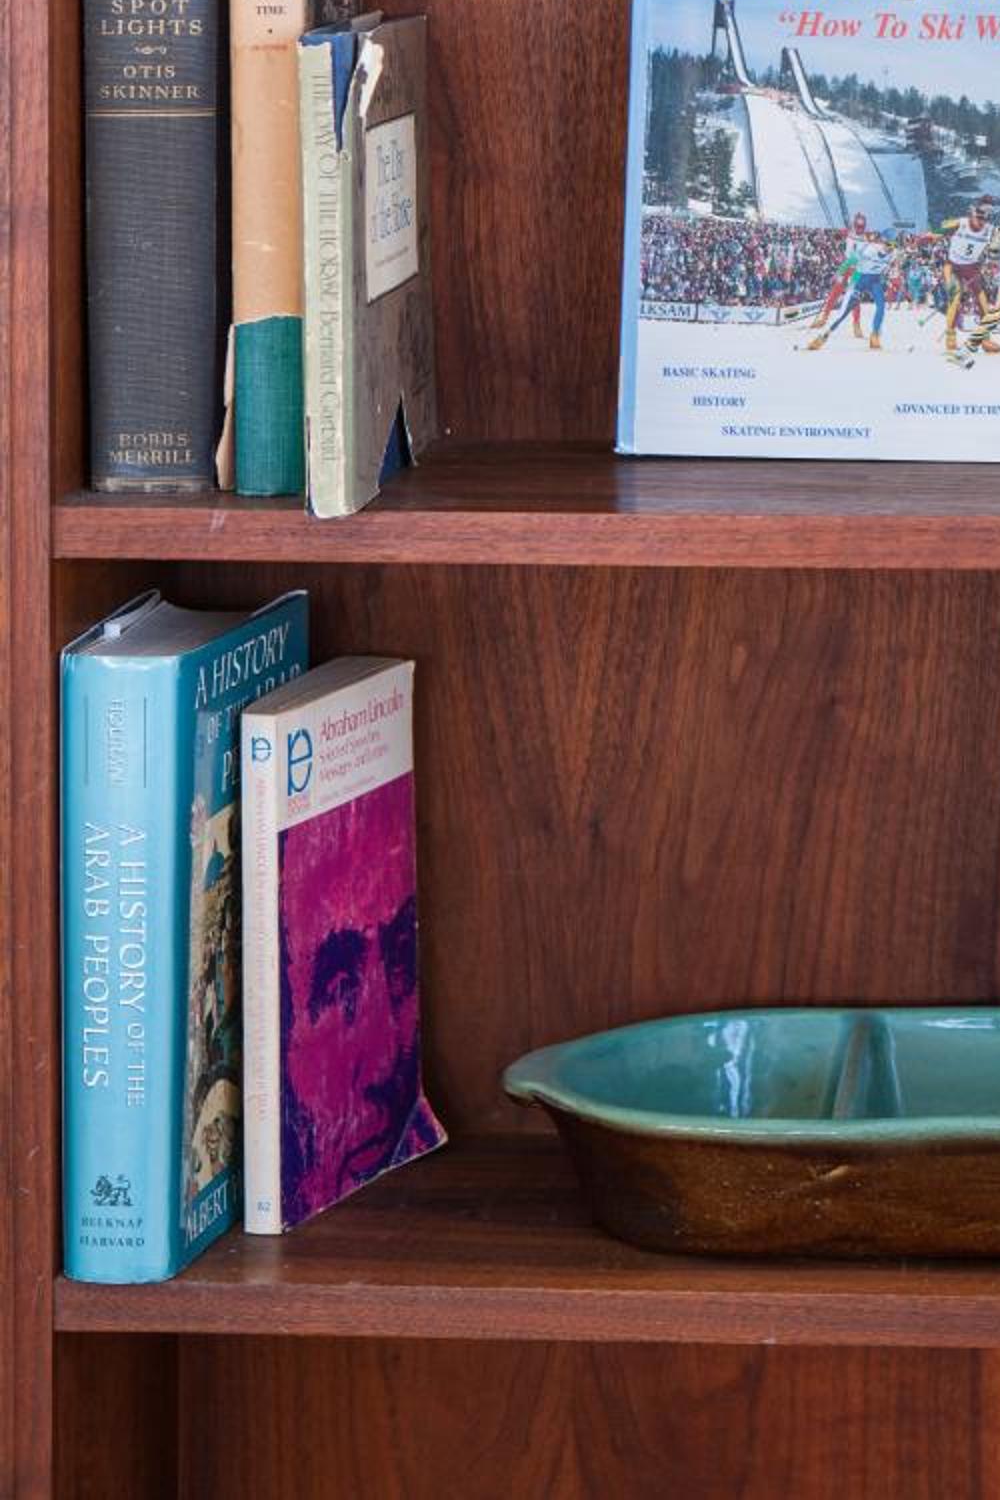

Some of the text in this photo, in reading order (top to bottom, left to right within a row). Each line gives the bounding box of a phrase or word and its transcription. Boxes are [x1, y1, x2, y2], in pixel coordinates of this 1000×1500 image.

[111, 0, 190, 15] SPOT
[256, 6, 287, 15] TIME
[101, 19, 204, 36] LIGHTS
[875, 13, 908, 39] To
[918, 13, 966, 42] Ski
[123, 66, 176, 79] OTIS
[100, 85, 200, 99] SKINNER
[662, 367, 757, 379] BASIC SKATING
[692, 396, 747, 407] HISTORY
[892, 404, 961, 416] ADVANCED
[721, 426, 872, 438] SKATING ENVIRONMENT
[119, 432, 190, 447] BOBBS
[110, 449, 194, 465] MERRILL
[195, 666, 207, 709] A
[211, 622, 289, 698] HISTORY
[319, 706, 369, 741] Abraham
[82, 822, 110, 1089] ARAB PEOPLES
[118, 824, 146, 1110] A HISTORY OF THE
[81, 1217, 144, 1229] BELKNAP
[79, 1236, 145, 1247] HARVARD
